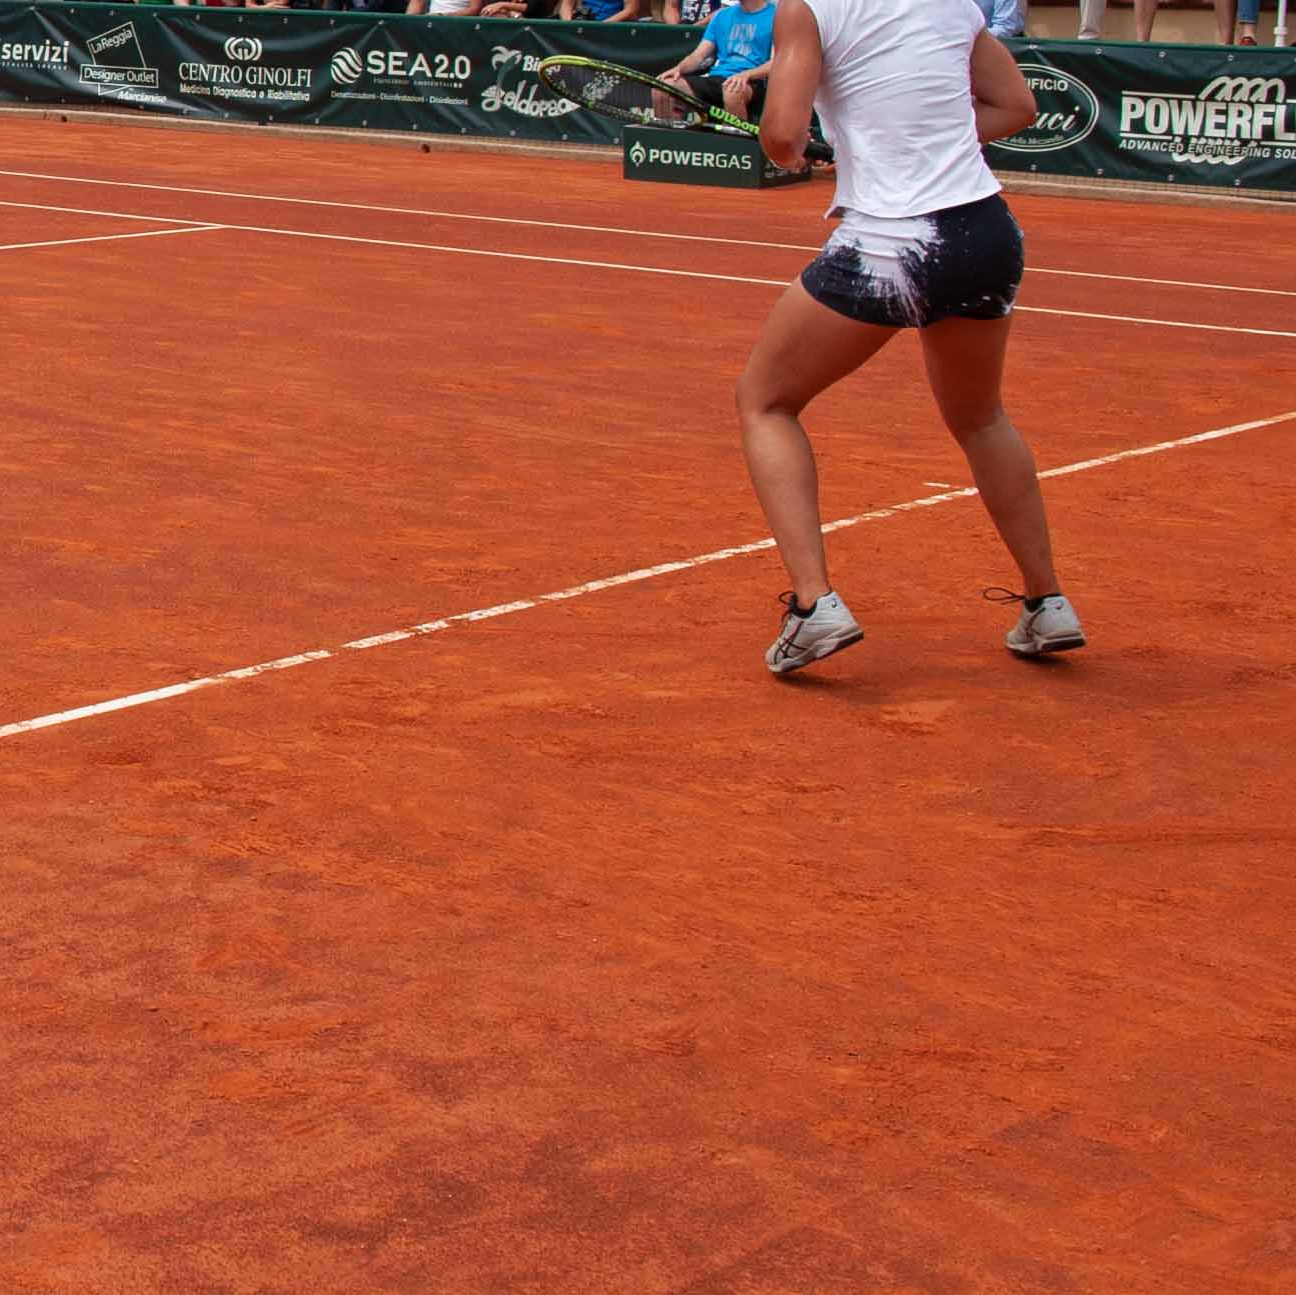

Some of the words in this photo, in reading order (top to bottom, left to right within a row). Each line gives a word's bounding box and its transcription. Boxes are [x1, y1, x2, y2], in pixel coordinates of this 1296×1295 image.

[83, 67, 126, 83] Designer
[126, 69, 155, 84] Outlet
[178, 62, 243, 84] CENTRO
[245, 65, 312, 88] GINOLFI
[1025, 77, 1069, 92] IFICIO
[1119, 95, 1296, 141] POWERFL
[648, 147, 753, 171] POWERGAS
[1119, 138, 1185, 153] ADVANCED
[1187, 142, 1272, 159] ENGINEERING
